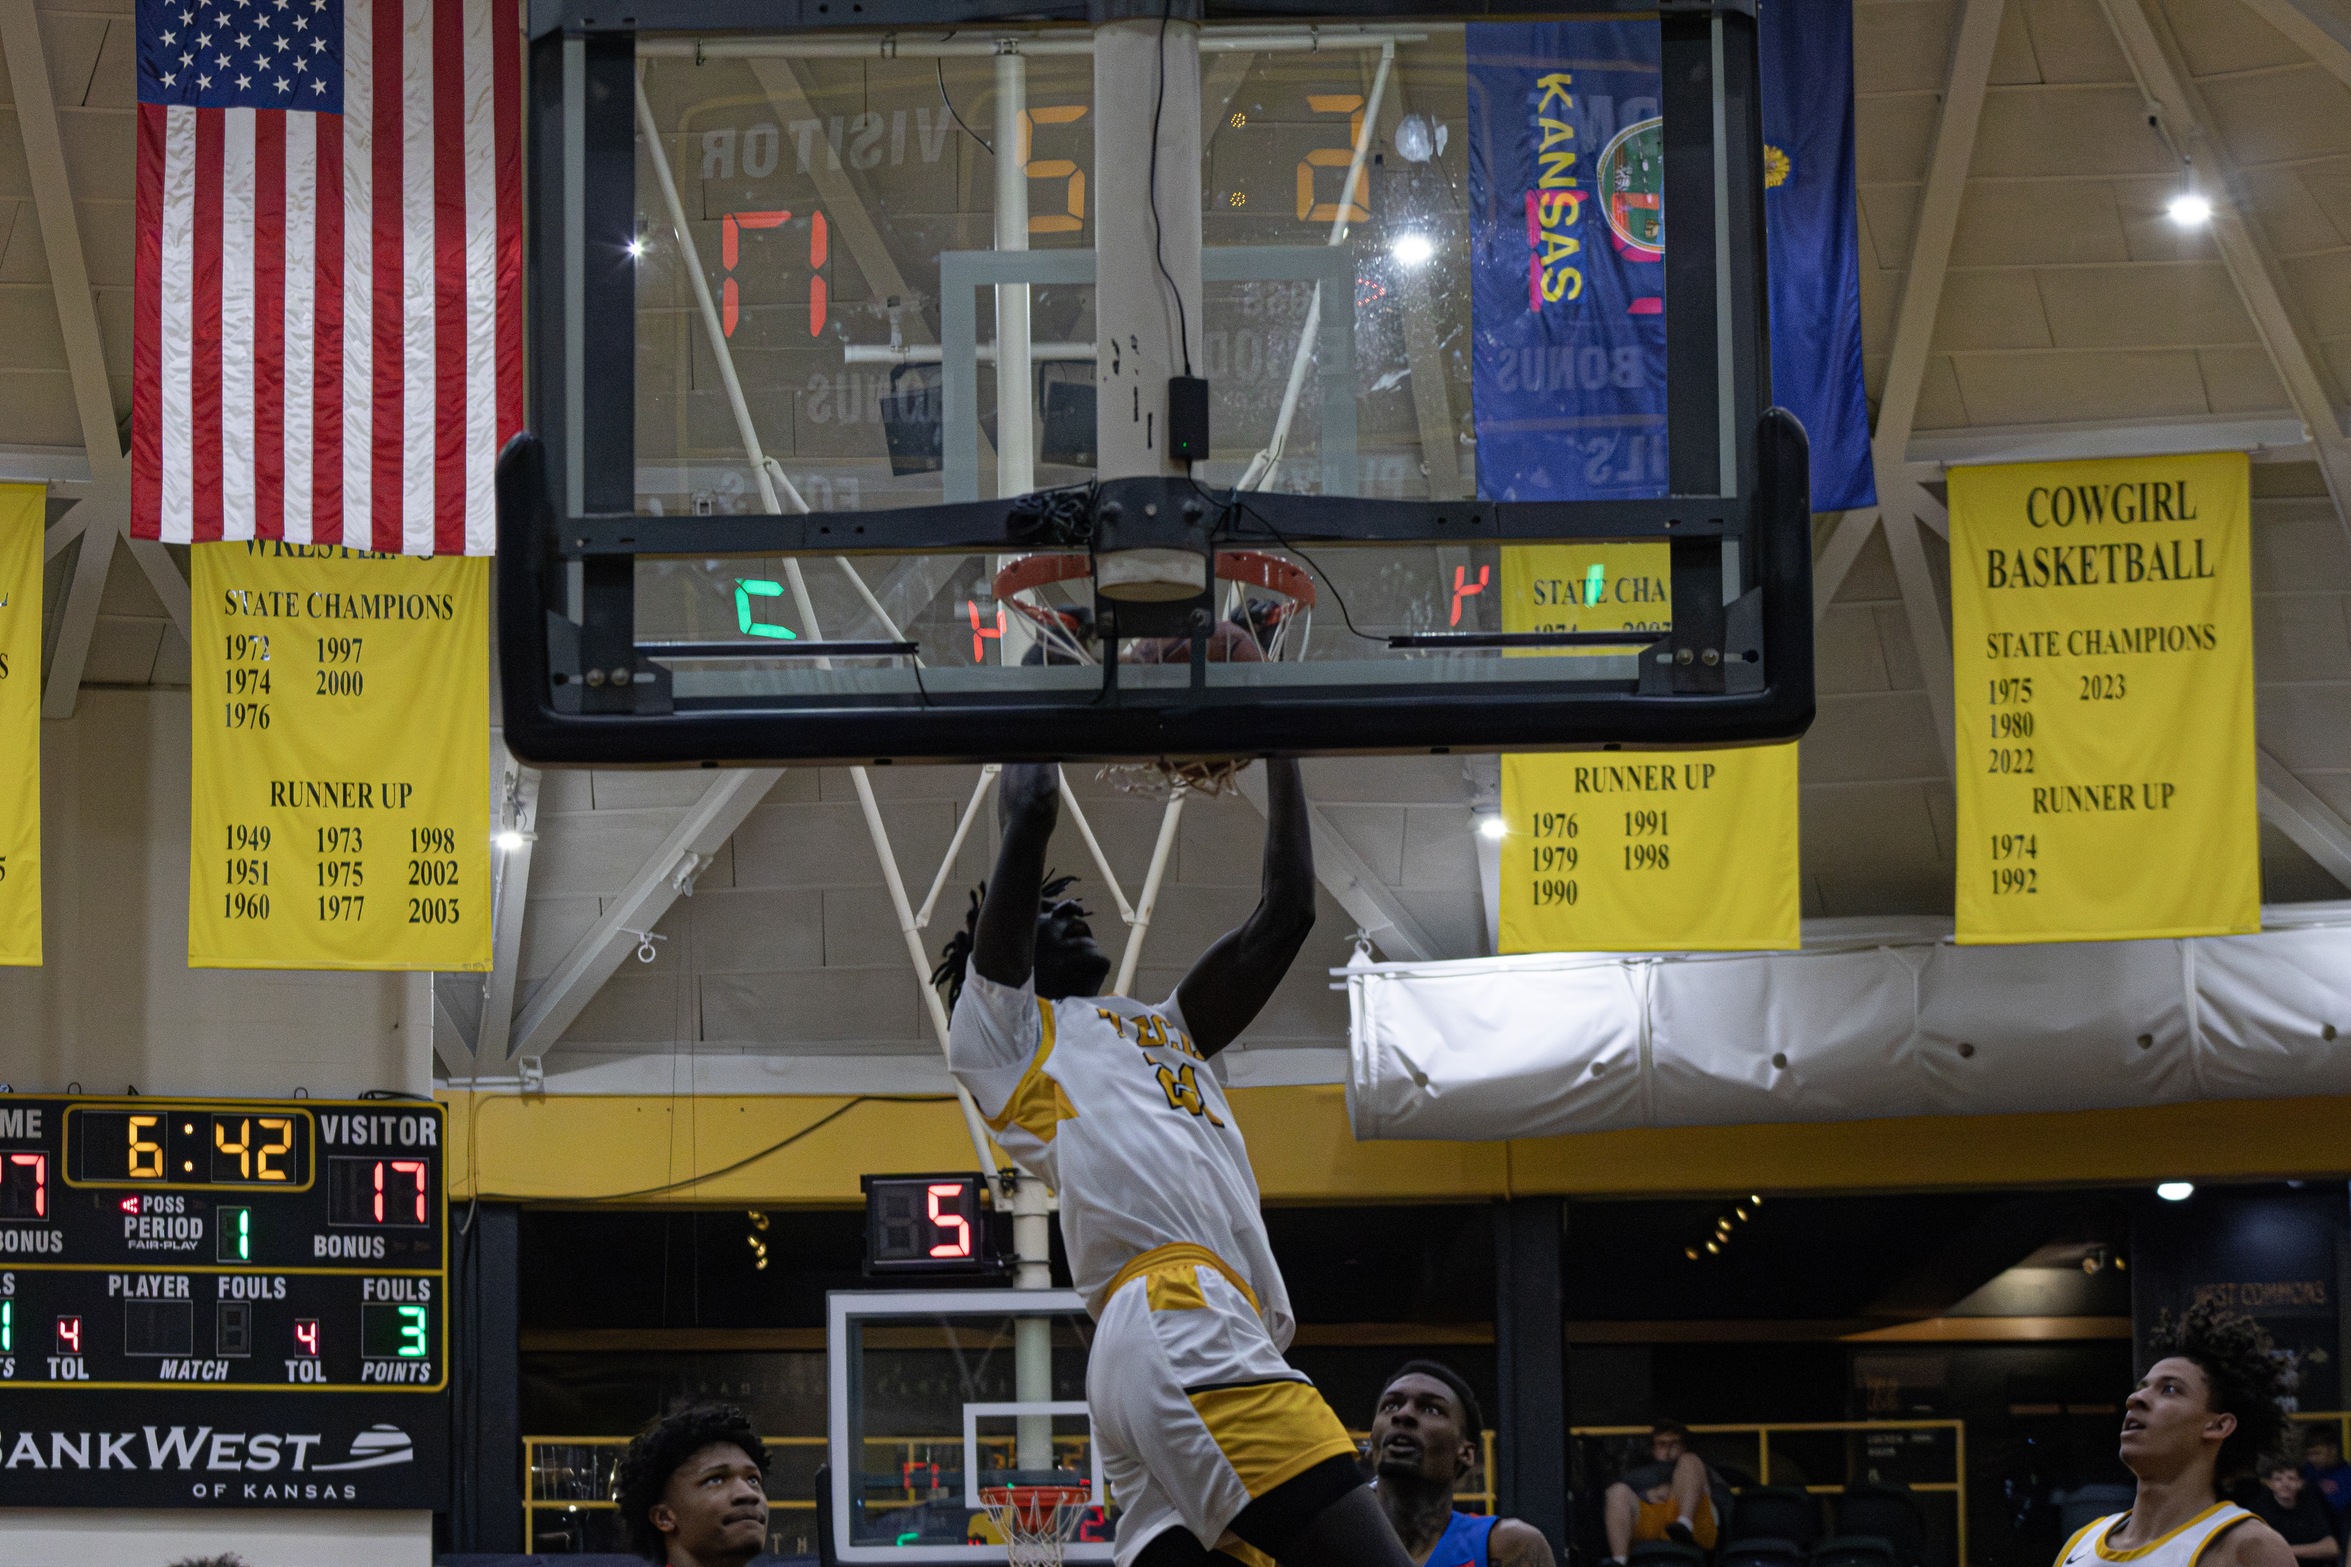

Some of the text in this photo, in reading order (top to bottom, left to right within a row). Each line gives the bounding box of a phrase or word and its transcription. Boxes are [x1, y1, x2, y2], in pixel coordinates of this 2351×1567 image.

[1537, 73, 1583, 303] KANSAS
[2026, 480, 2198, 528] COWGIRL
[1986, 538, 2216, 589] BASKETBALL
[224, 588, 454, 620] STATE CHAMPIONS
[1534, 578, 1607, 606] STATE
[225, 634, 271, 662] 1972
[316, 637, 363, 664] 1997
[1986, 623, 2217, 660] STATE CHAMPIONS
[225, 668, 271, 695] 1974
[315, 670, 364, 697] 2000
[1988, 677, 2033, 706] 1975
[2079, 673, 2127, 702] 2023
[224, 702, 271, 730] 1976
[1989, 711, 2034, 739] 1980
[1986, 747, 2035, 775] 2022
[1574, 763, 1717, 794] RUNNER UP
[270, 780, 413, 810] RUNNER UP
[2032, 781, 2176, 815] RUNNER UP
[1533, 812, 1578, 839] 1976
[1624, 810, 1669, 837] 1991
[225, 824, 271, 852] 1949
[316, 827, 363, 854] 1973
[410, 827, 455, 854] 1998
[1990, 833, 2038, 862] 1974
[1533, 846, 1578, 872] 1979
[1623, 844, 1670, 871] 1998
[225, 858, 270, 886] 1951
[317, 861, 364, 888] 1975
[408, 859, 459, 886] 2002
[1991, 867, 2039, 895] 1992
[224, 892, 270, 920] 1960
[1533, 879, 1578, 907] 1990
[317, 894, 365, 922] 1977
[408, 897, 460, 924] 2003
[321, 1114, 437, 1147] VISITOR
[128, 1115, 293, 1181] 6:42
[143, 1195, 185, 1213] POSS
[373, 1160, 426, 1224] 17
[124, 1216, 203, 1240] PERIOD
[239, 1208, 249, 1260] 1
[927, 1183, 971, 1258] 5
[313, 1234, 385, 1259] BONUS
[108, 1274, 190, 1298] PLAYER
[218, 1276, 286, 1299] FOULS
[363, 1277, 431, 1302] FOULS
[59, 1318, 79, 1352] 4
[297, 1321, 317, 1356] 4
[398, 1304, 427, 1358] 3
[47, 1357, 90, 1380] TOL
[159, 1359, 229, 1381] MATCH
[285, 1360, 327, 1382] TOL
[361, 1361, 431, 1382] POINTS
[0, 1425, 322, 1472] ANKWEST
[193, 1483, 357, 1500] OF KANSAS
